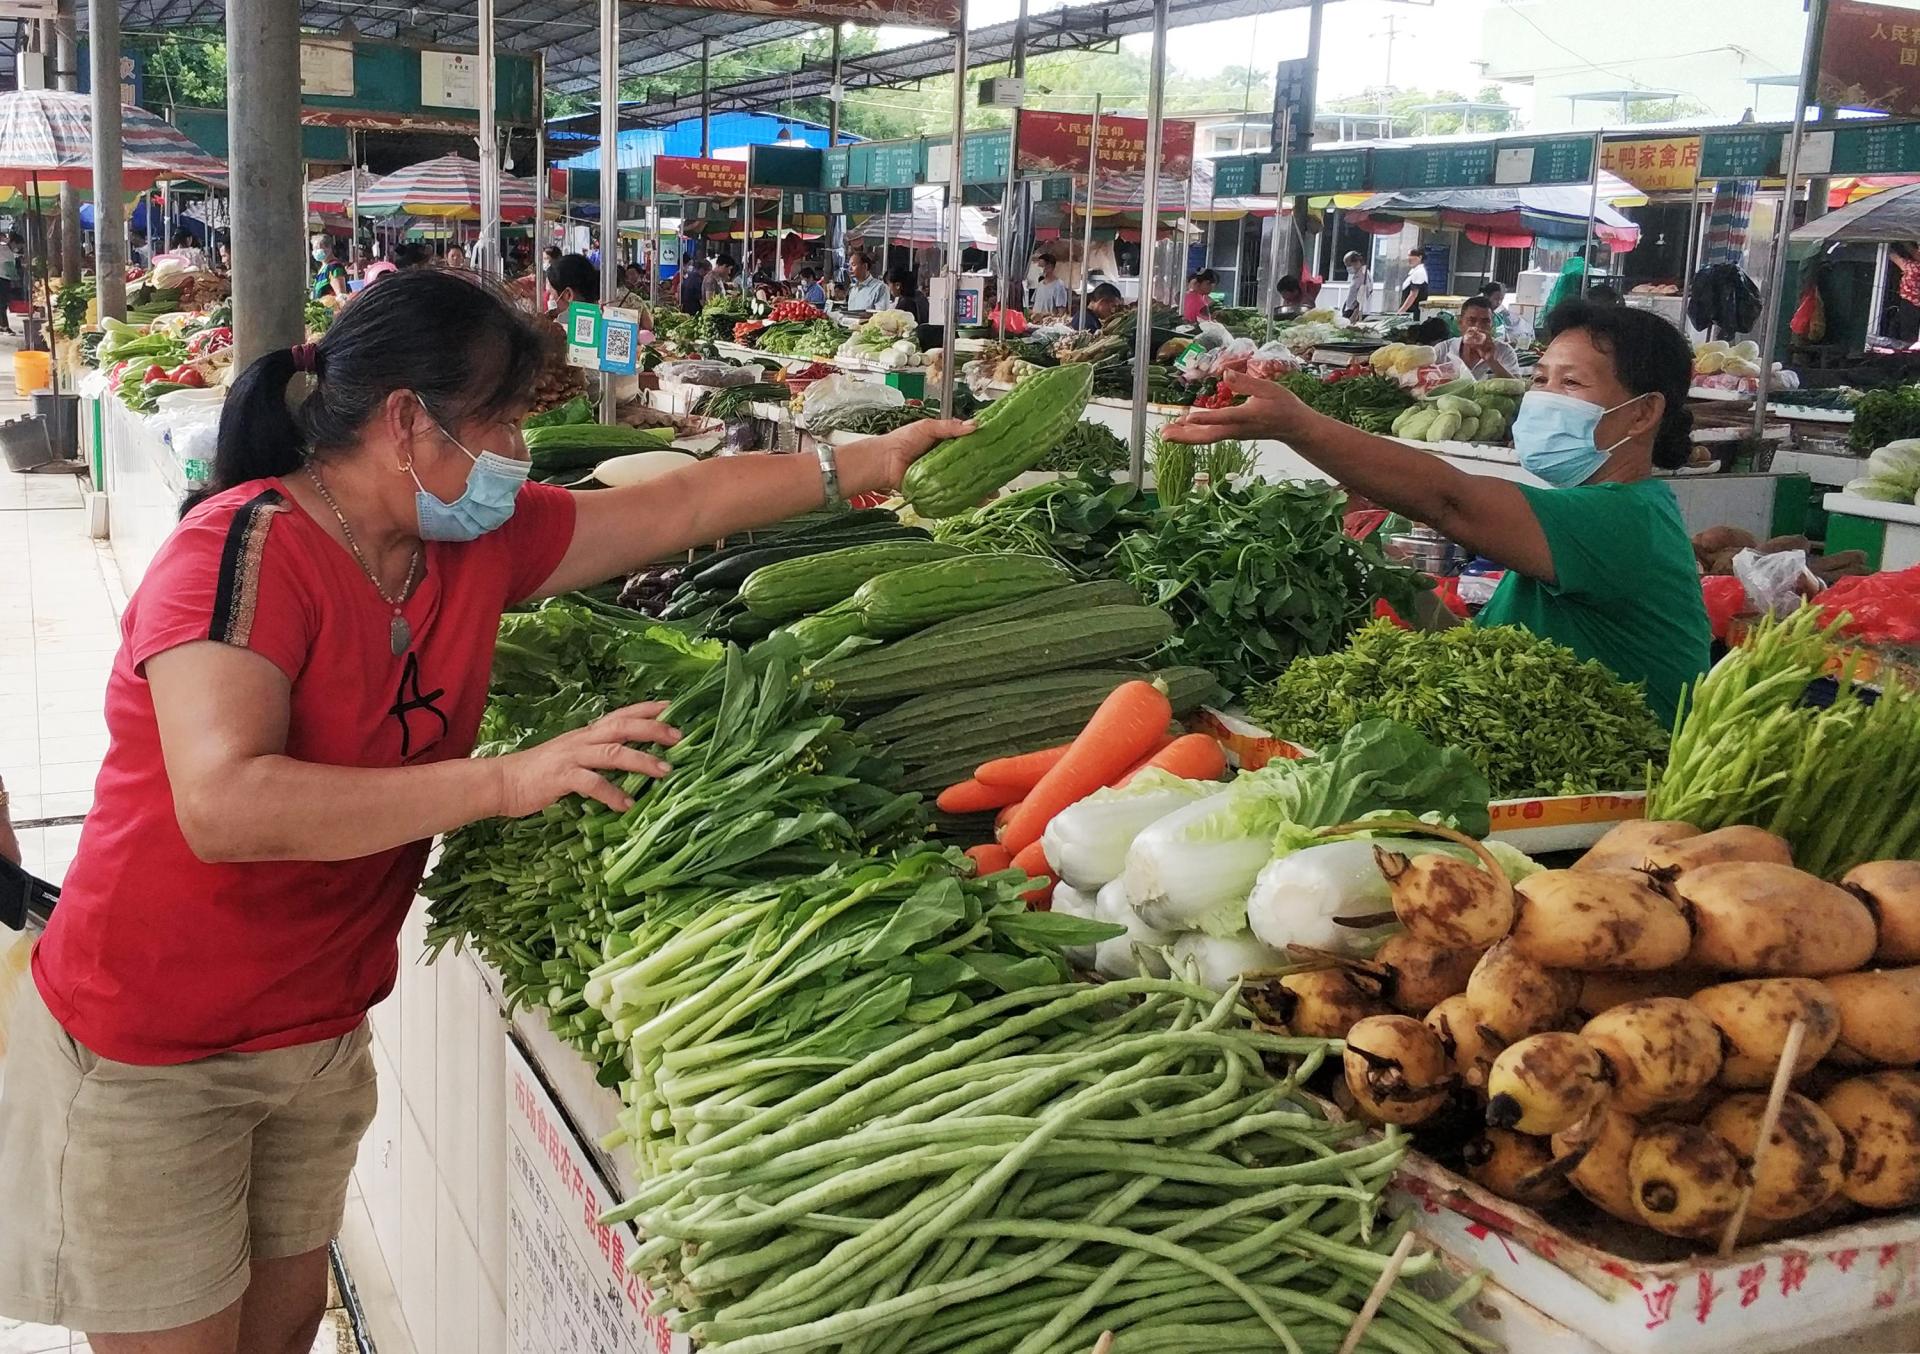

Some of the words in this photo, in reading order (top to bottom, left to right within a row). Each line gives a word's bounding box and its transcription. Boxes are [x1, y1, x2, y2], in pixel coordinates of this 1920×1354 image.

[1054, 122, 1124, 137] 人民有信仰
[681, 161, 731, 173] 人民有信仰
[696, 171, 746, 182] 国家有力量
[713, 179, 746, 189] 民族有
